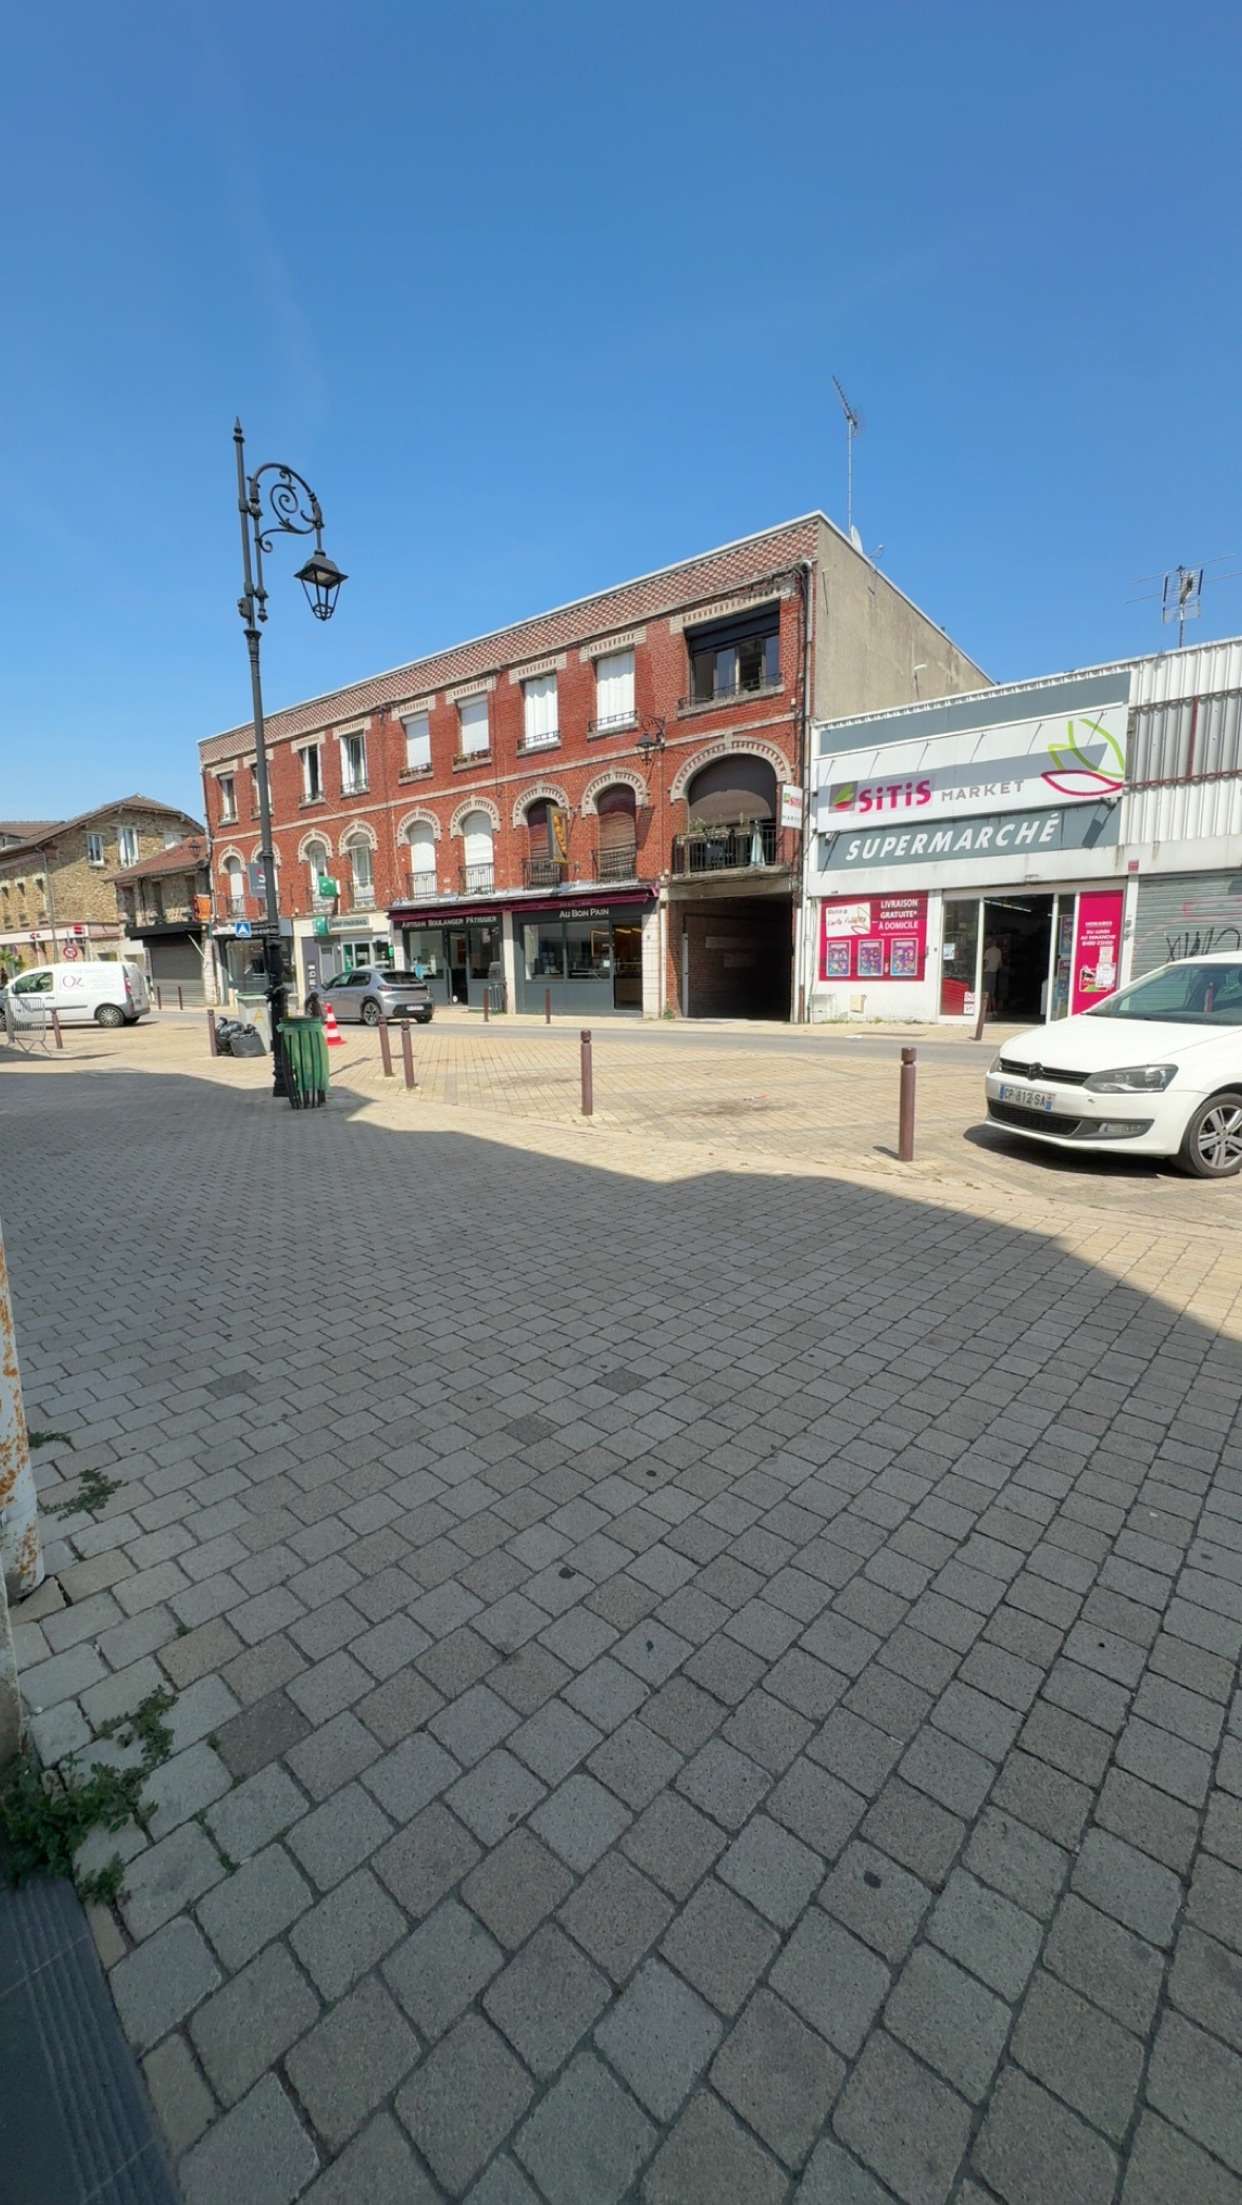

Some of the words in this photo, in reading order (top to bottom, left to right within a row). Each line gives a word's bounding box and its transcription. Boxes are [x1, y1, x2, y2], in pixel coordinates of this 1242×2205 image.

[942, 780, 1024, 801] MARKET
[845, 813, 1060, 861] SUPERMARCHÉ
[881, 899, 919, 909] LIVRAISON
[885, 920, 919, 930] DOMICILE
